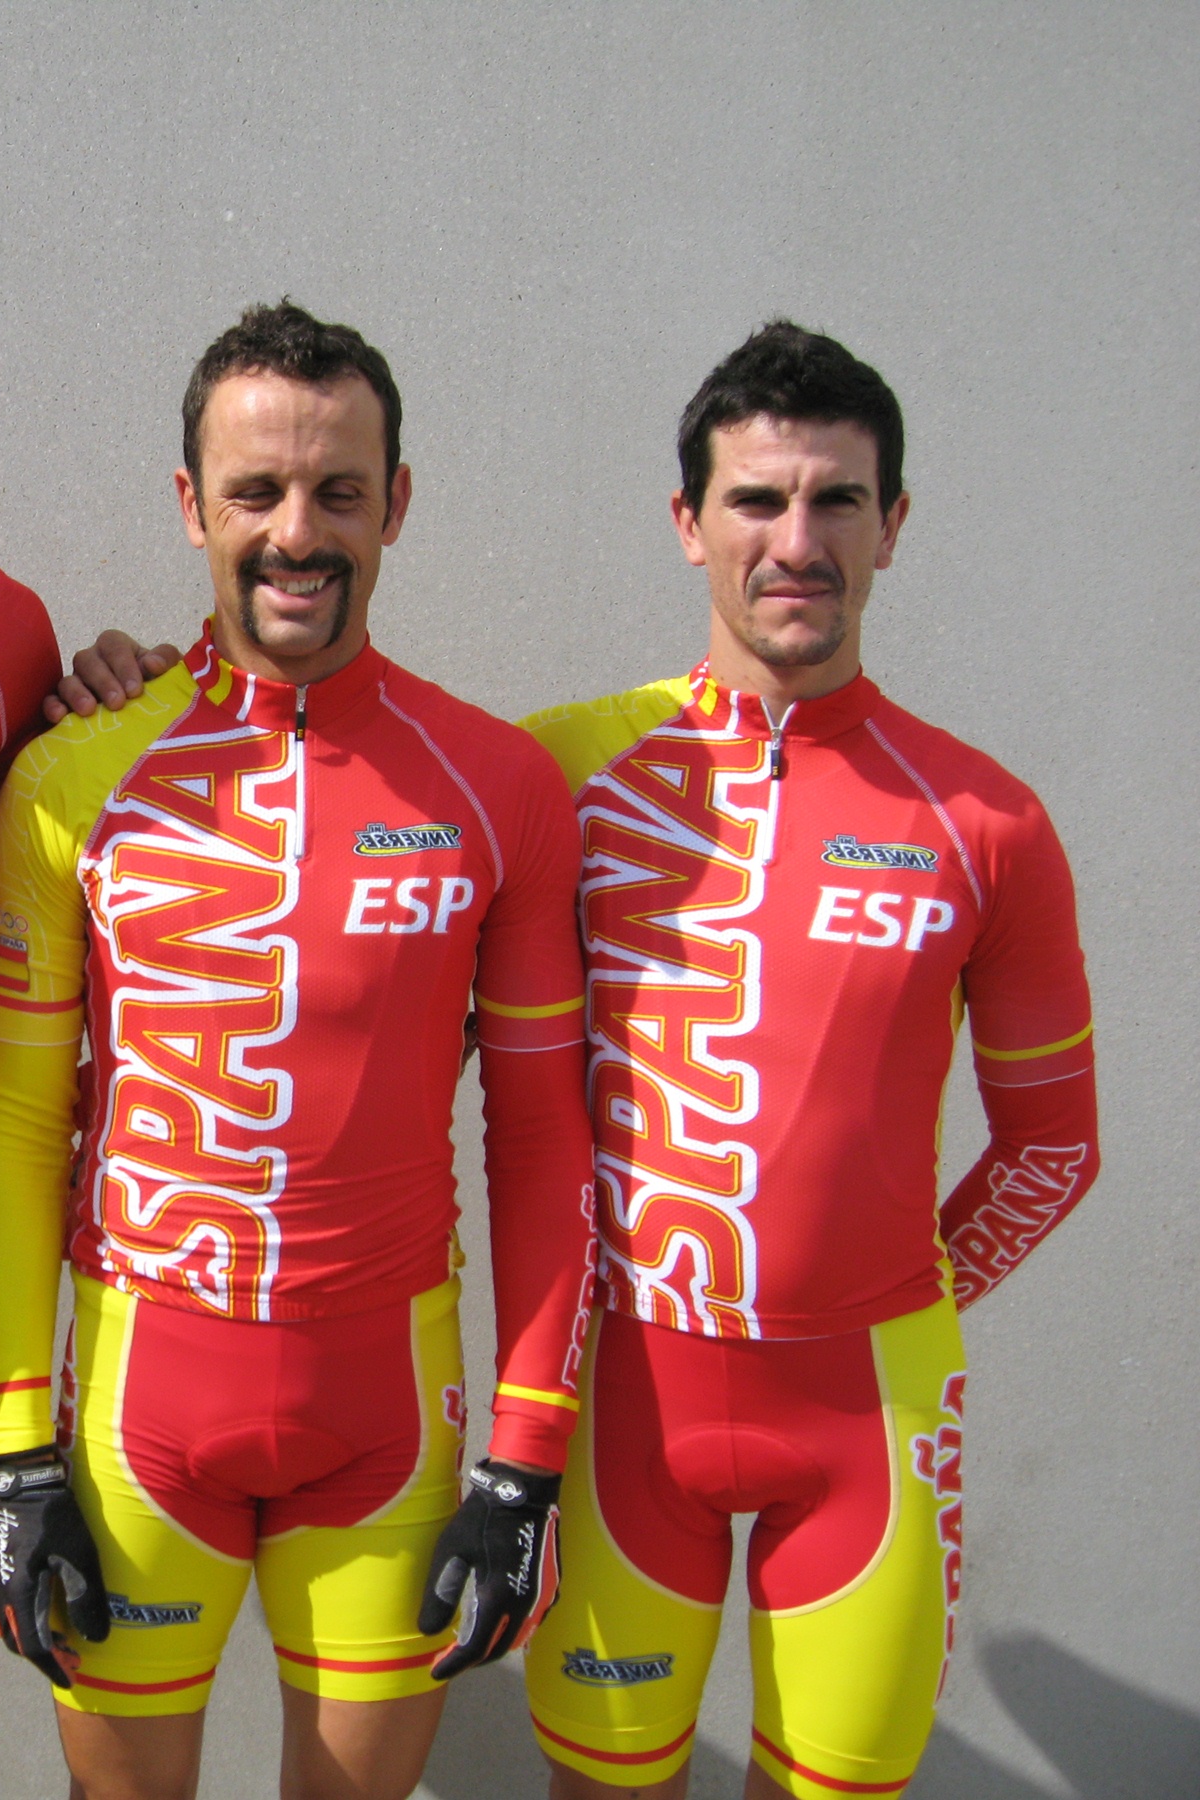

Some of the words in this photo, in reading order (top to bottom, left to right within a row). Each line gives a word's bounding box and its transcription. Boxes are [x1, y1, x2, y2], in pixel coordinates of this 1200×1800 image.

[343, 876, 475, 935] ESP
[808, 885, 955, 952] ESP
[947, 1142, 1087, 1316] SPAÑA
[506, 1519, 536, 1597] Hermida
